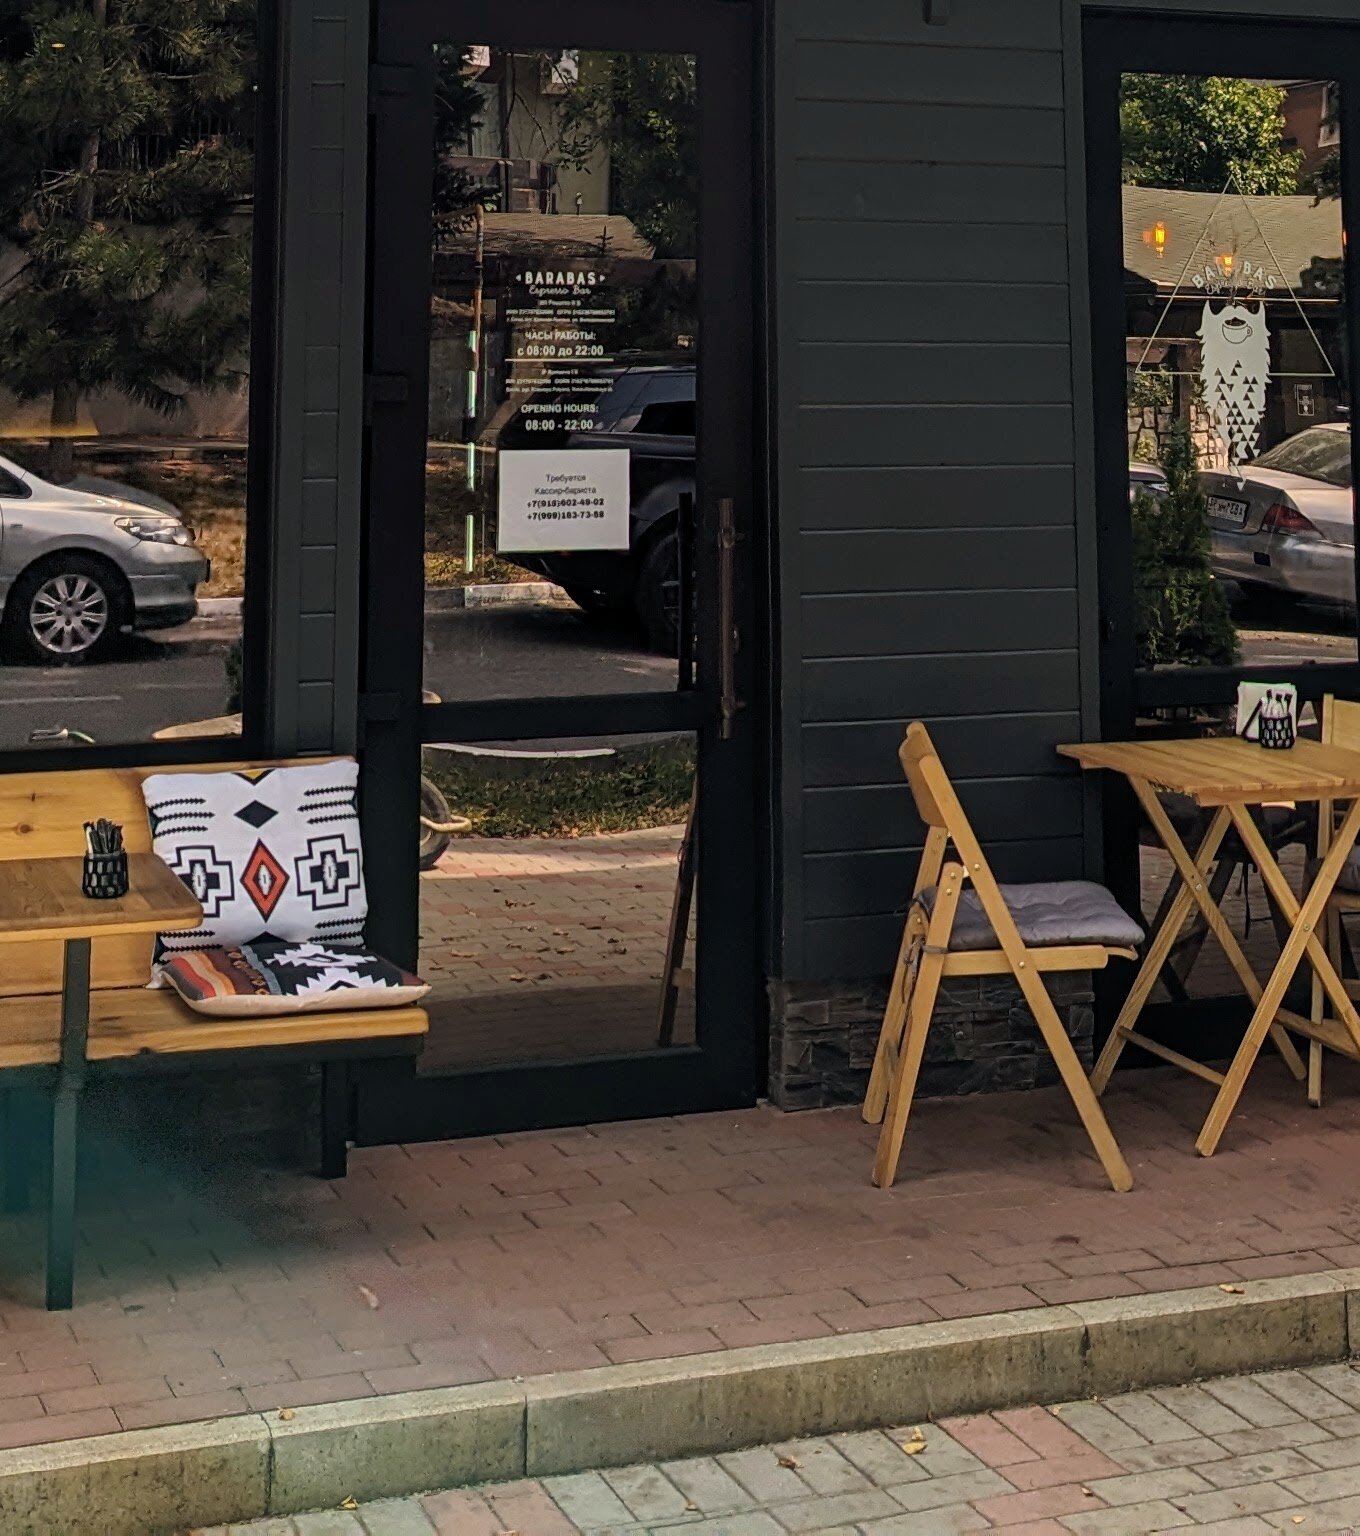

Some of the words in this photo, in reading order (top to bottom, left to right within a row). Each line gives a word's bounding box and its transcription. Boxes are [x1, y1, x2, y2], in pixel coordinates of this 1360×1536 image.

[525, 271, 596, 285] BARABAS
[1191, 260, 1277, 289] BABAS
[529, 284, 570, 297] Espresso
[572, 284, 592, 296] Bar
[525, 331, 552, 340] ЧАСЫ
[555, 331, 596, 340] РАБОТЫ:
[526, 345, 555, 356] 08:00
[557, 347, 573, 356] до
[575, 345, 604, 356] 22:00
[521, 404, 562, 413] OPENING
[563, 404, 598, 413] HOURS:
[525, 420, 555, 430] 08:00
[564, 419, 594, 430] 22:00
[545, 473, 586, 483] Требуется
